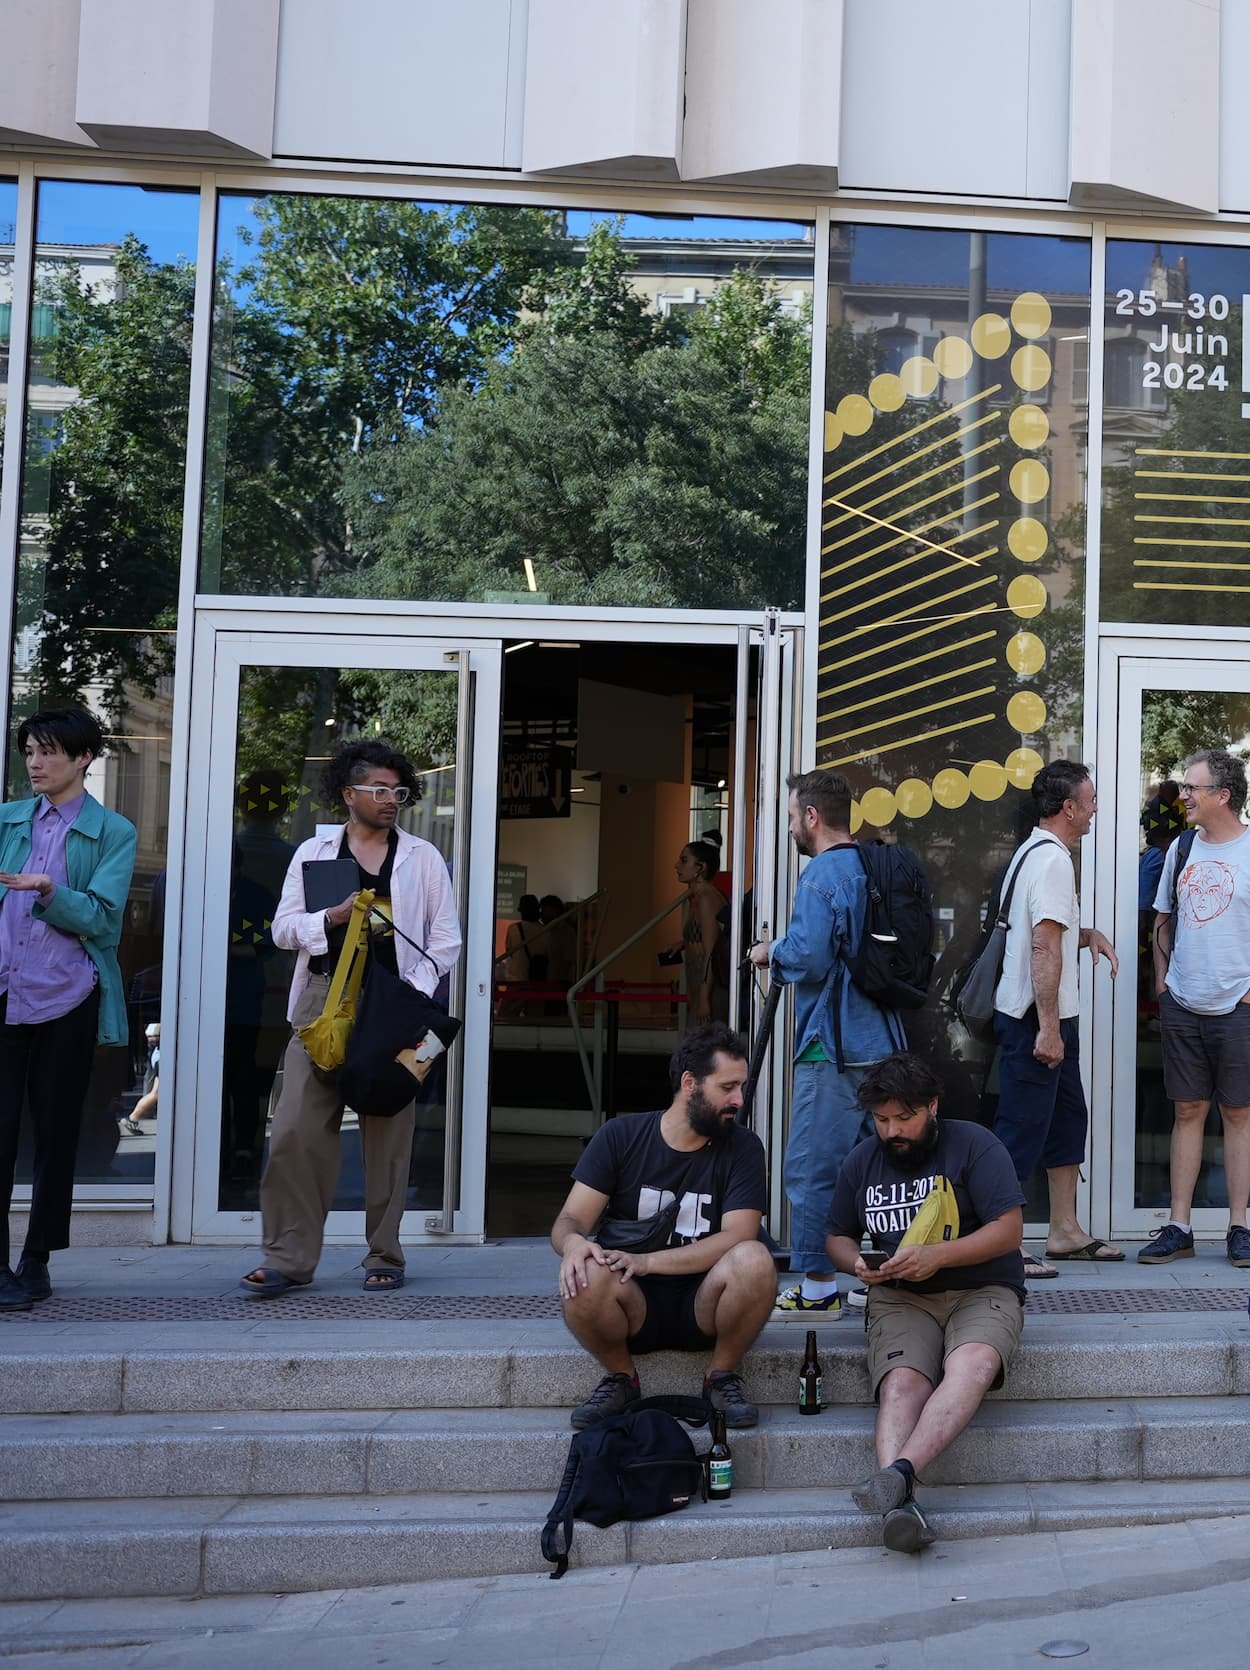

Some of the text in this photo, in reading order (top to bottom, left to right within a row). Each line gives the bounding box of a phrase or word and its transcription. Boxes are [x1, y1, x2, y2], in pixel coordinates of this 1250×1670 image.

[1149, 324, 1229, 356] Juin
[1142, 362, 1229, 392] 2024
[866, 1175, 935, 1206] 05-11-201
[866, 1206, 919, 1234] NOAIL
